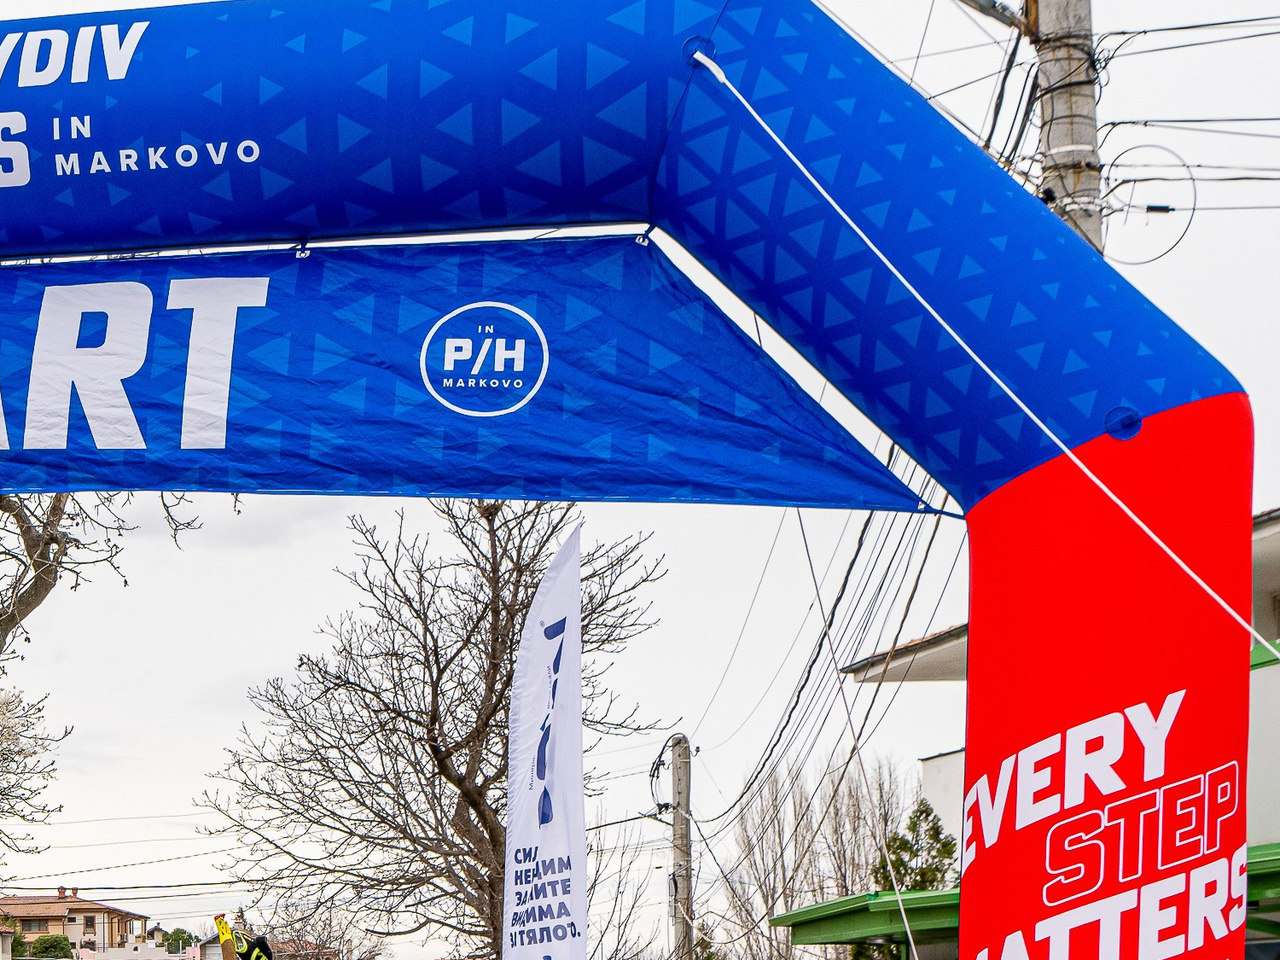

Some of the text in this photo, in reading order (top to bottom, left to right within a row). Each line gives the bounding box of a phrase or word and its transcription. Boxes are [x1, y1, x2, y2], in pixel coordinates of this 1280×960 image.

[53, 115, 91, 140] IN
[55, 140, 261, 175] MARKOVO
[478, 325, 494, 334] IN
[443, 338, 526, 375] P/H
[443, 378, 523, 388] MARKOVO
[961, 688, 1187, 879] EVERY
[1042, 760, 1239, 907] STEP
